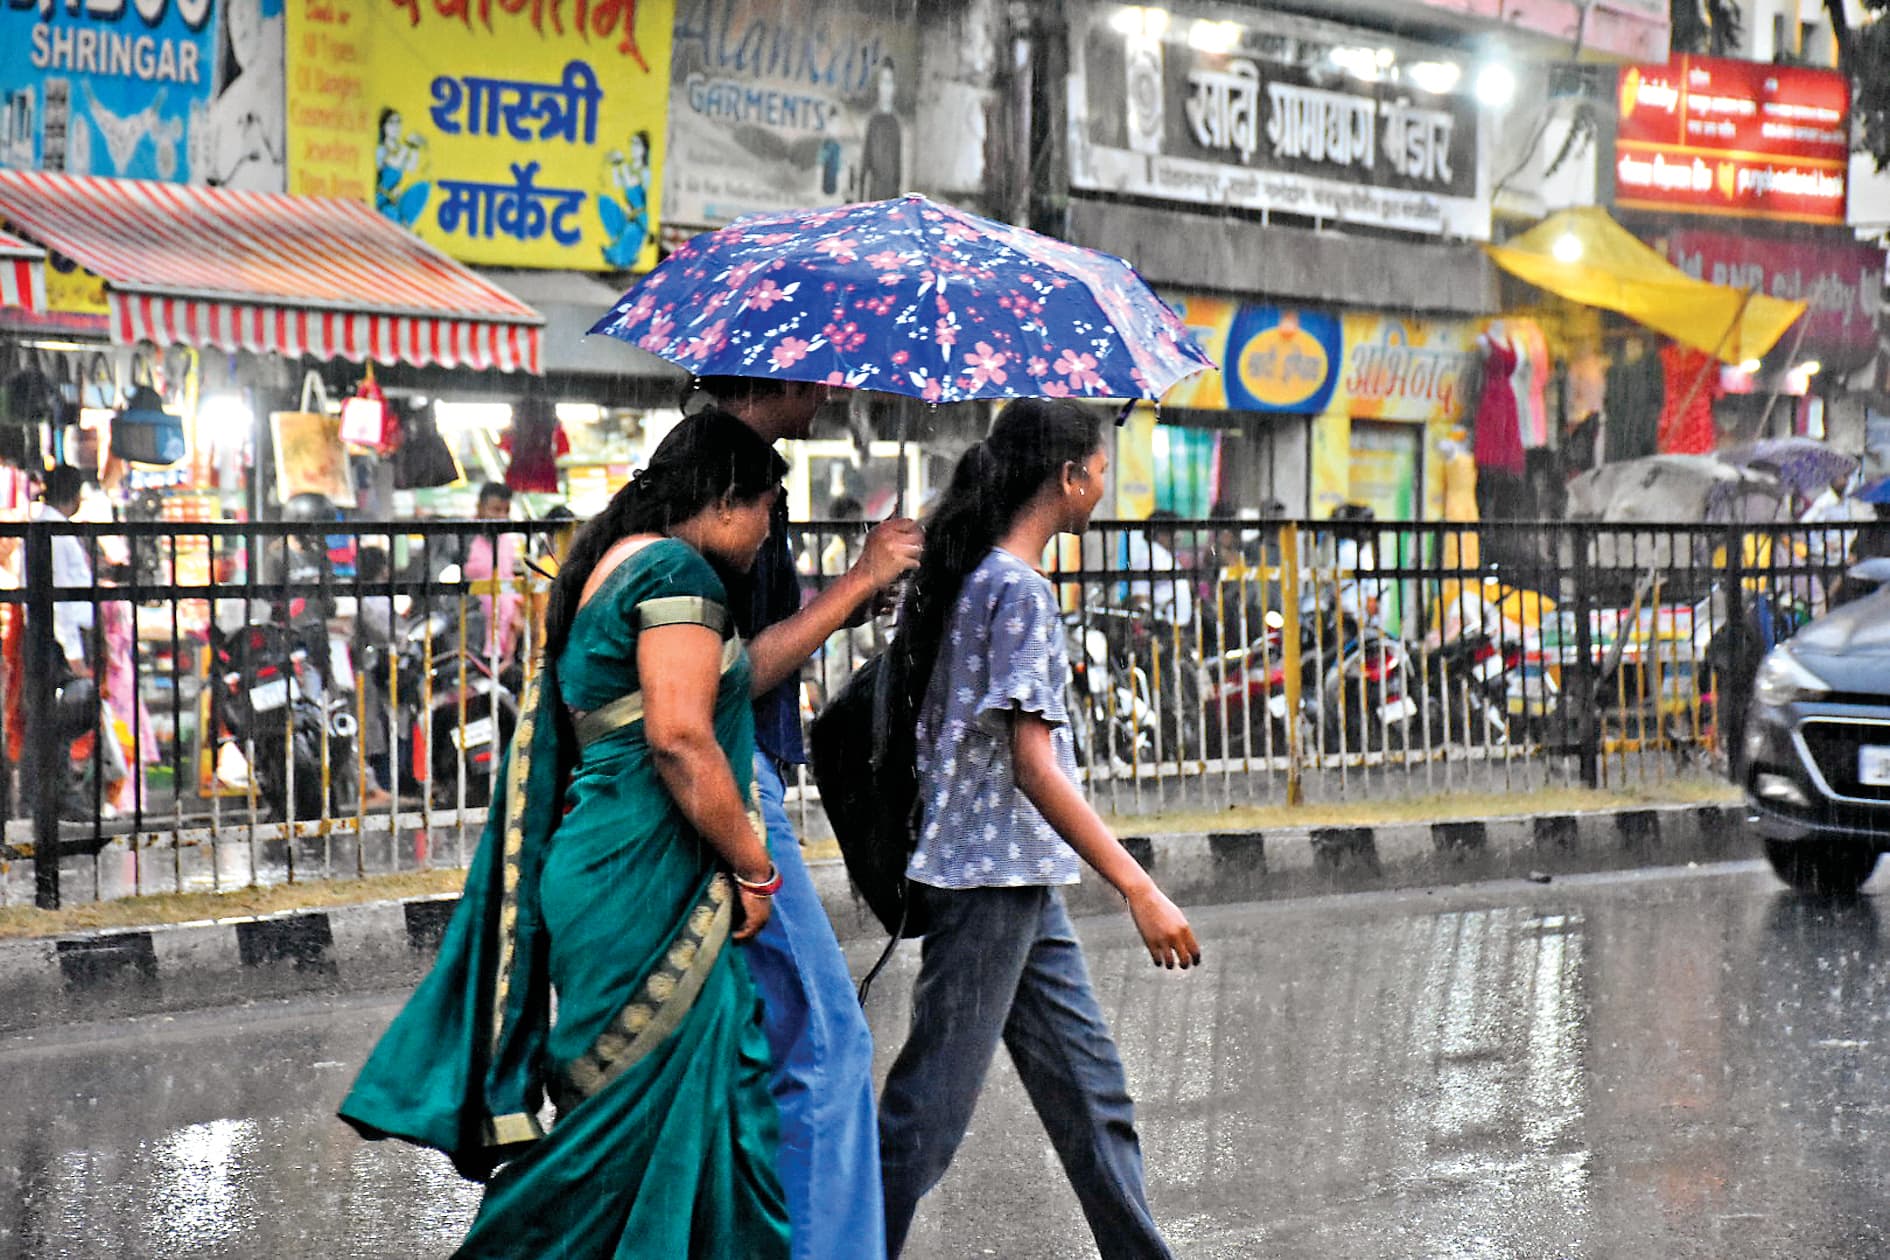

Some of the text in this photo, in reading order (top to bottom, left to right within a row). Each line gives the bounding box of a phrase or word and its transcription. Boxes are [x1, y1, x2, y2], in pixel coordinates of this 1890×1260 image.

[31, 22, 201, 84] SHRINGAR
[429, 58, 605, 145] शास्त्री
[687, 74, 828, 131] GARMENTS
[1186, 58, 1260, 164] खादी
[436, 160, 588, 247] मार्केट
